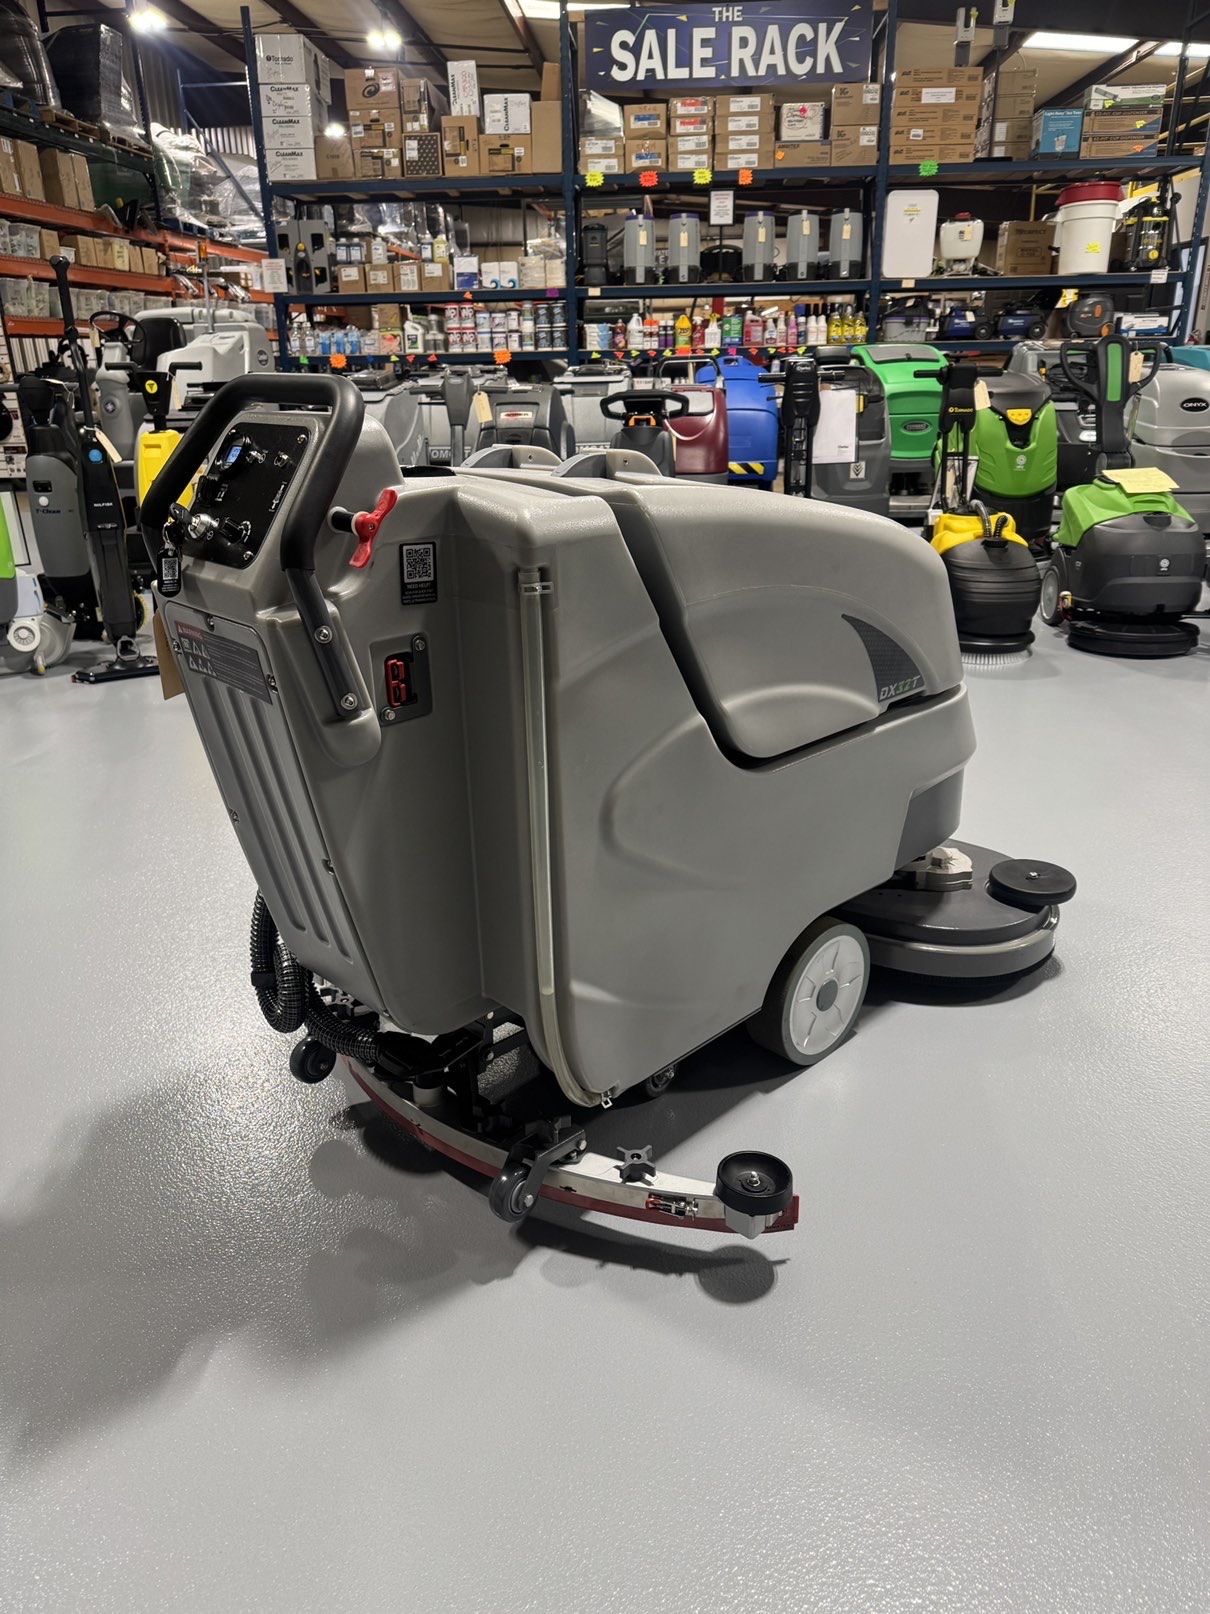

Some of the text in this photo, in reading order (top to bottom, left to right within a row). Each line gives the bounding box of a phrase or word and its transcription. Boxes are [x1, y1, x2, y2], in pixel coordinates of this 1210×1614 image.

[712, 6, 743, 22] THE
[610, 21, 846, 82] SALE RACK
